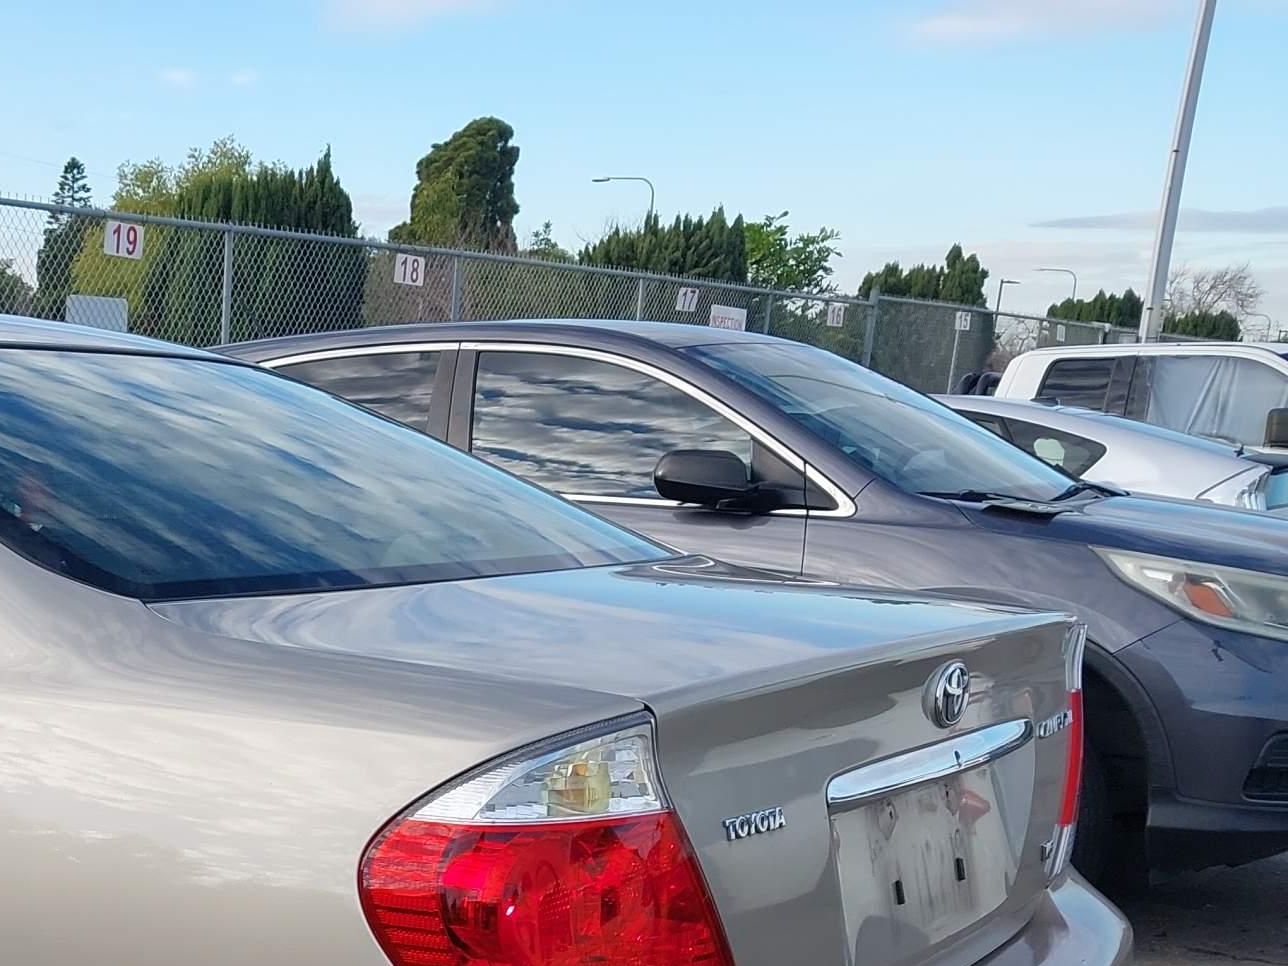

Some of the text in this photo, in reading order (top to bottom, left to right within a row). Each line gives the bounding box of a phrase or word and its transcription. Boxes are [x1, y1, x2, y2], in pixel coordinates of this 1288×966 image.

[112, 223, 138, 256] 19
[400, 256, 420, 283] 18
[682, 288, 697, 310] 17
[722, 806, 787, 841] TOYOTA
